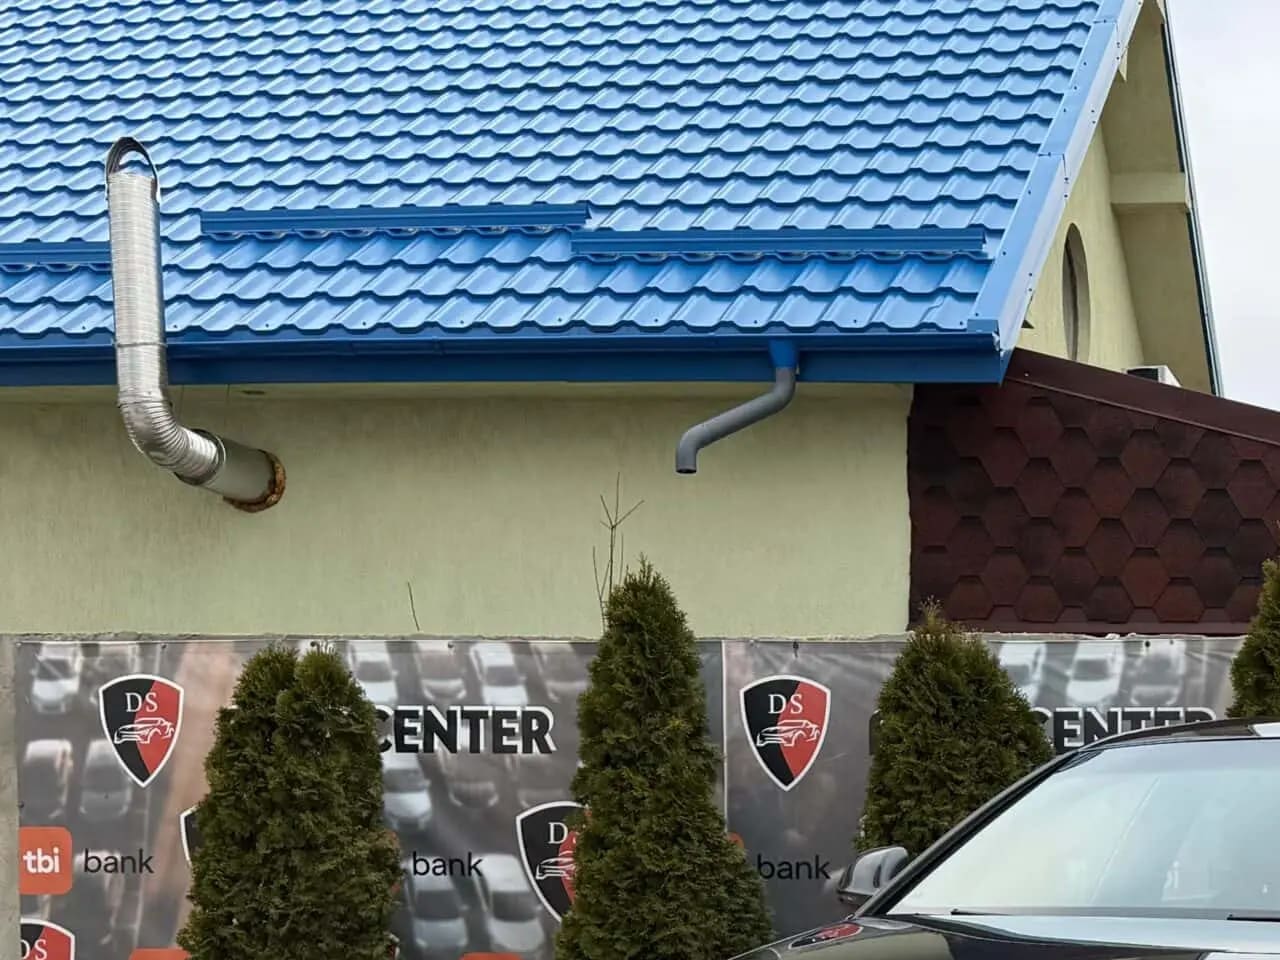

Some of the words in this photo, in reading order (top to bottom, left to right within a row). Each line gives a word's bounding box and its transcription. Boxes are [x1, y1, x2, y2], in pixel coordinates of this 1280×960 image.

[126, 692, 158, 713] DS
[768, 693, 804, 715] DS
[24, 847, 60, 873] tbi
[83, 849, 154, 874] bank
[412, 852, 484, 877] bank
[757, 853, 831, 880] bank
